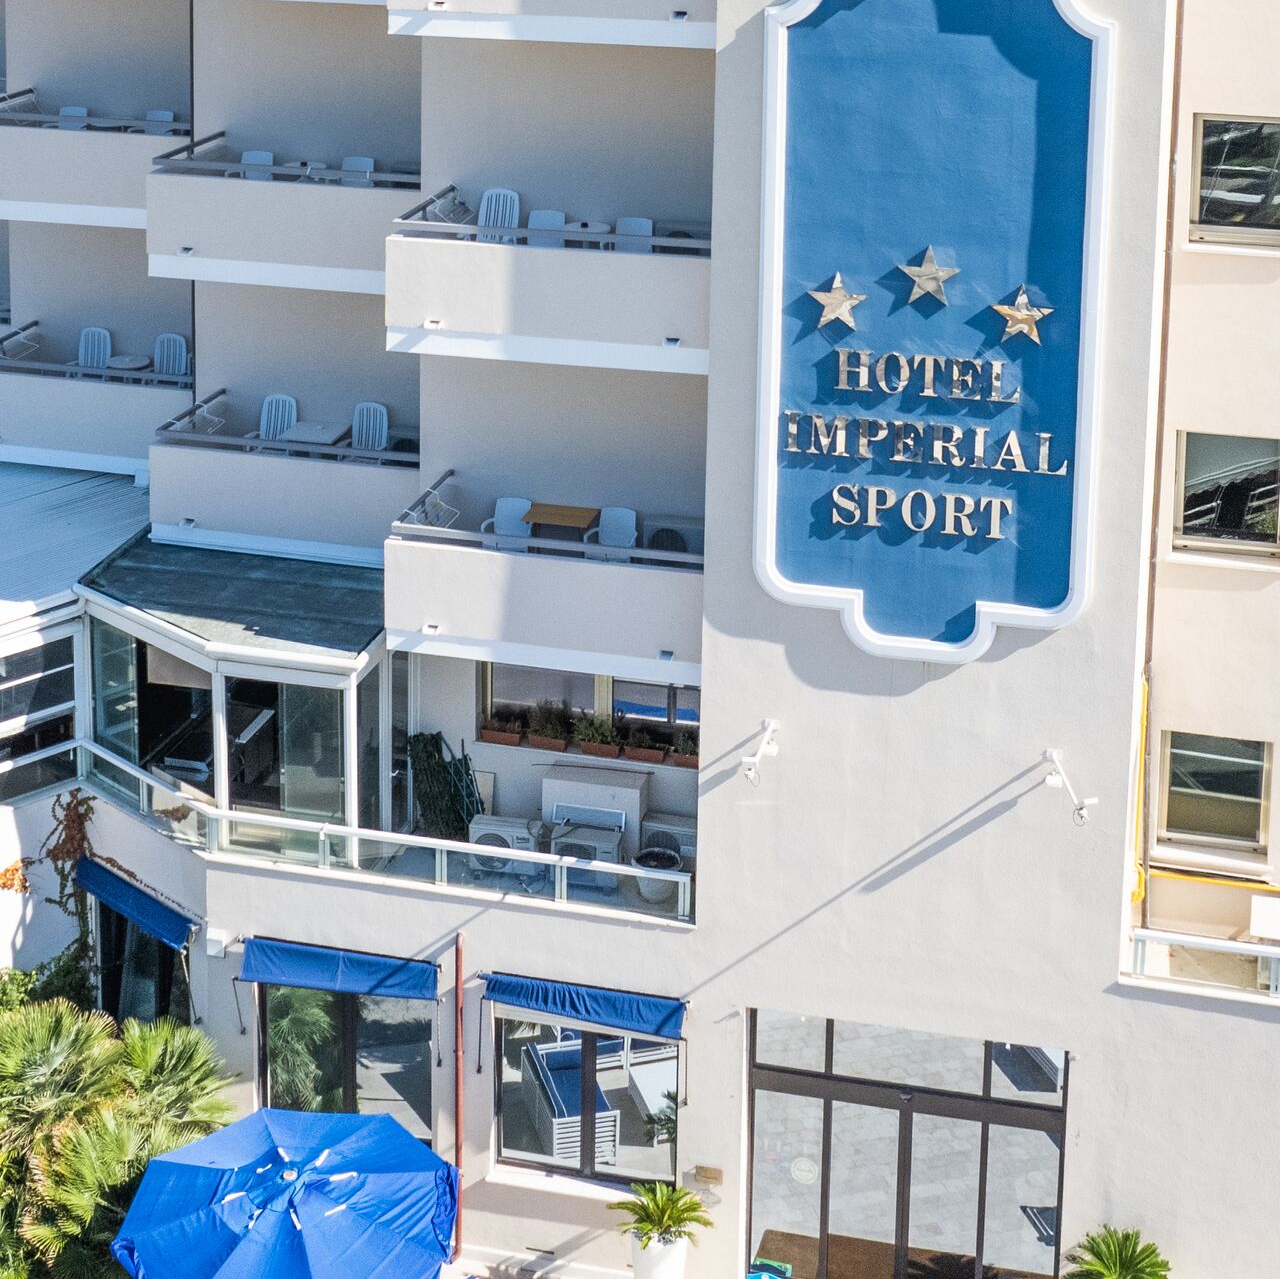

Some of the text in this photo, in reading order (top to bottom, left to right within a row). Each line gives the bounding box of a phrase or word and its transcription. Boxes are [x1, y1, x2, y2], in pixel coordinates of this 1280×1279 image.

[833, 347, 1021, 404] HOTEL
[783, 409, 1068, 476] IMPERIAL
[831, 483, 1013, 540] SPORT
